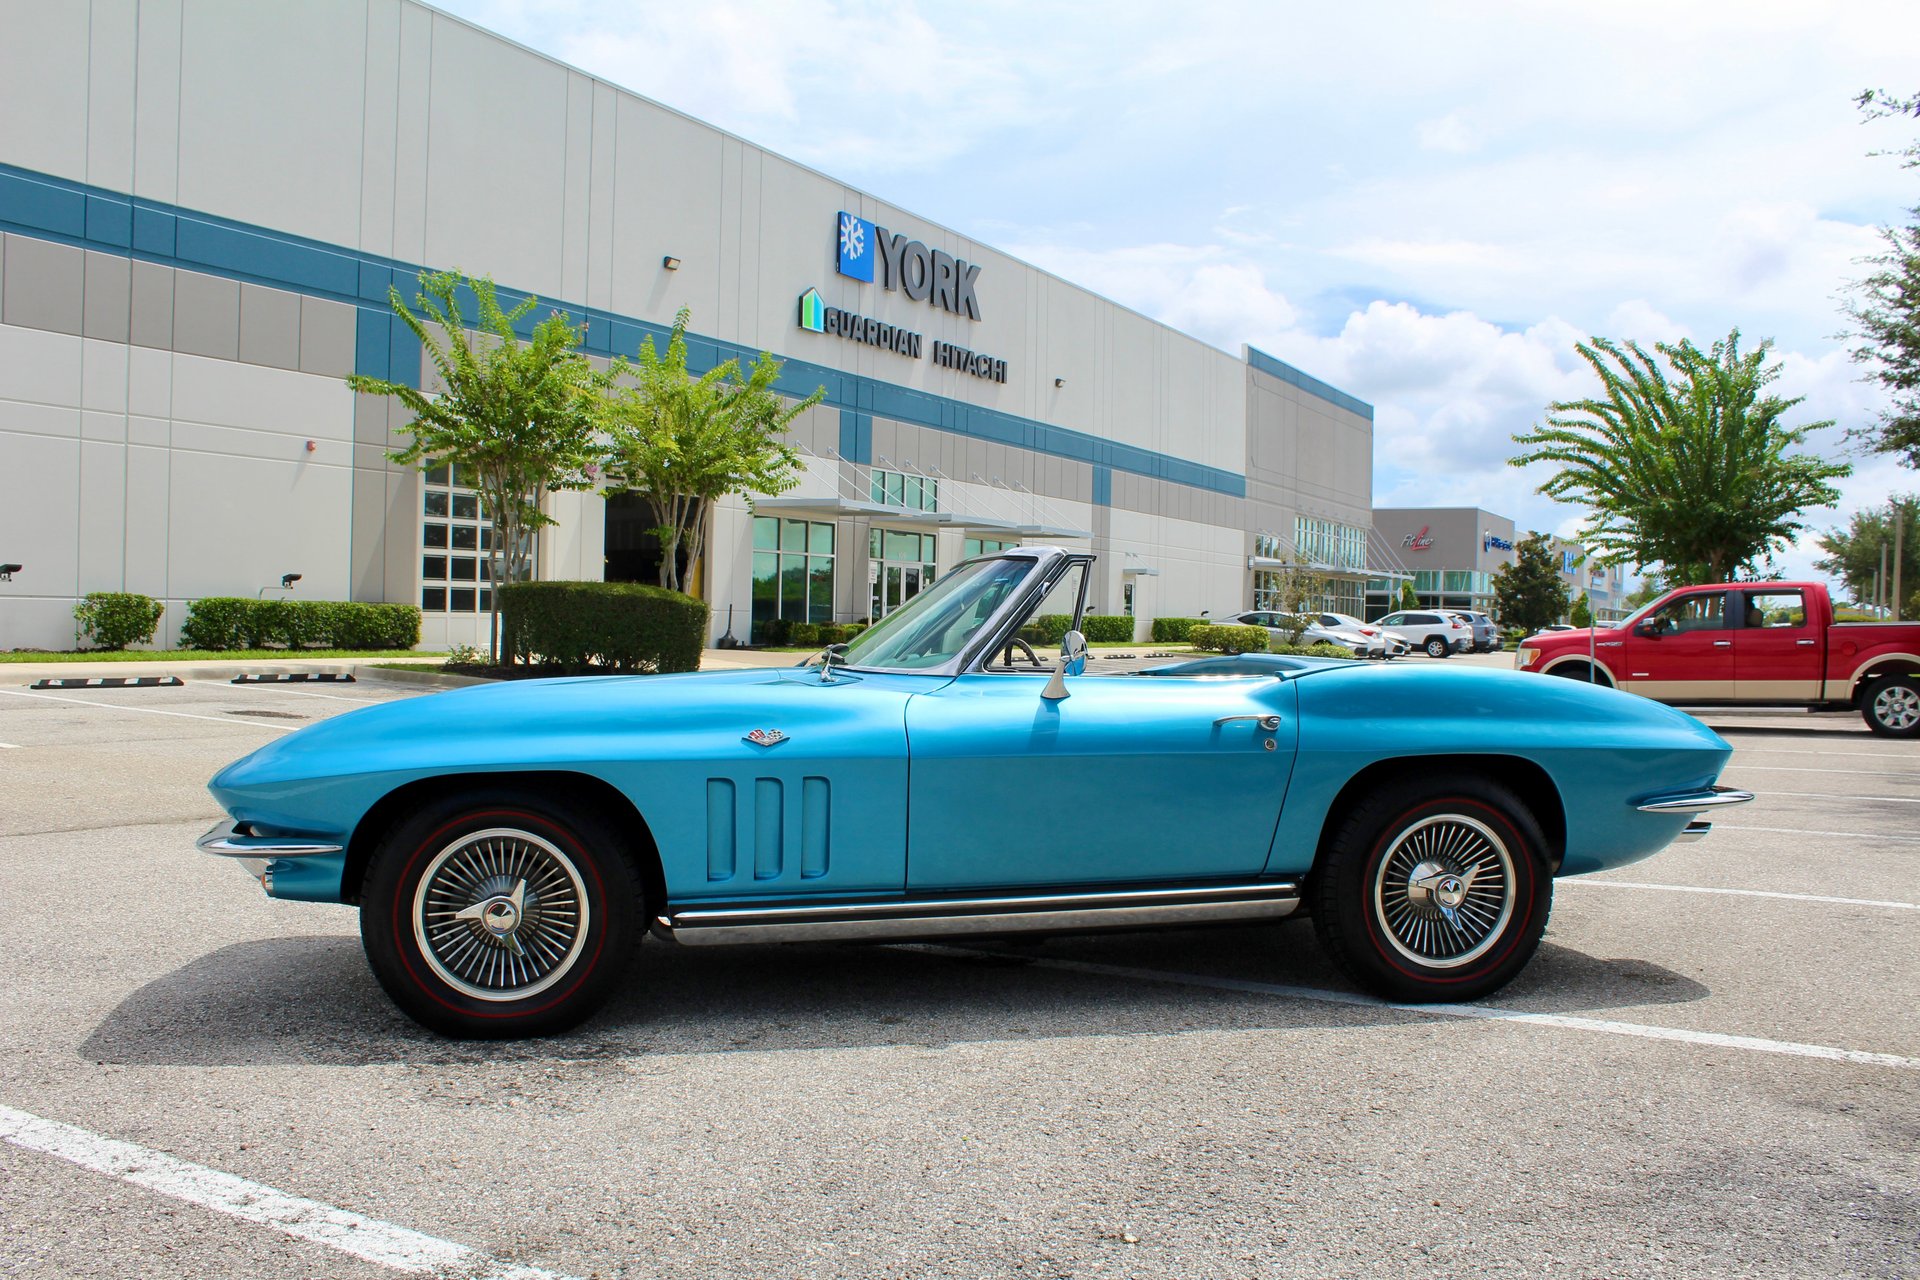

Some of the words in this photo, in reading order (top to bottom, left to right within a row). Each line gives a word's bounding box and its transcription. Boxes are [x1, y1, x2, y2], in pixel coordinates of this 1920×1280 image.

[876, 226, 982, 322] YORK
[824, 307, 922, 359] GUARDIAN
[933, 340, 1007, 384] HITACHI
